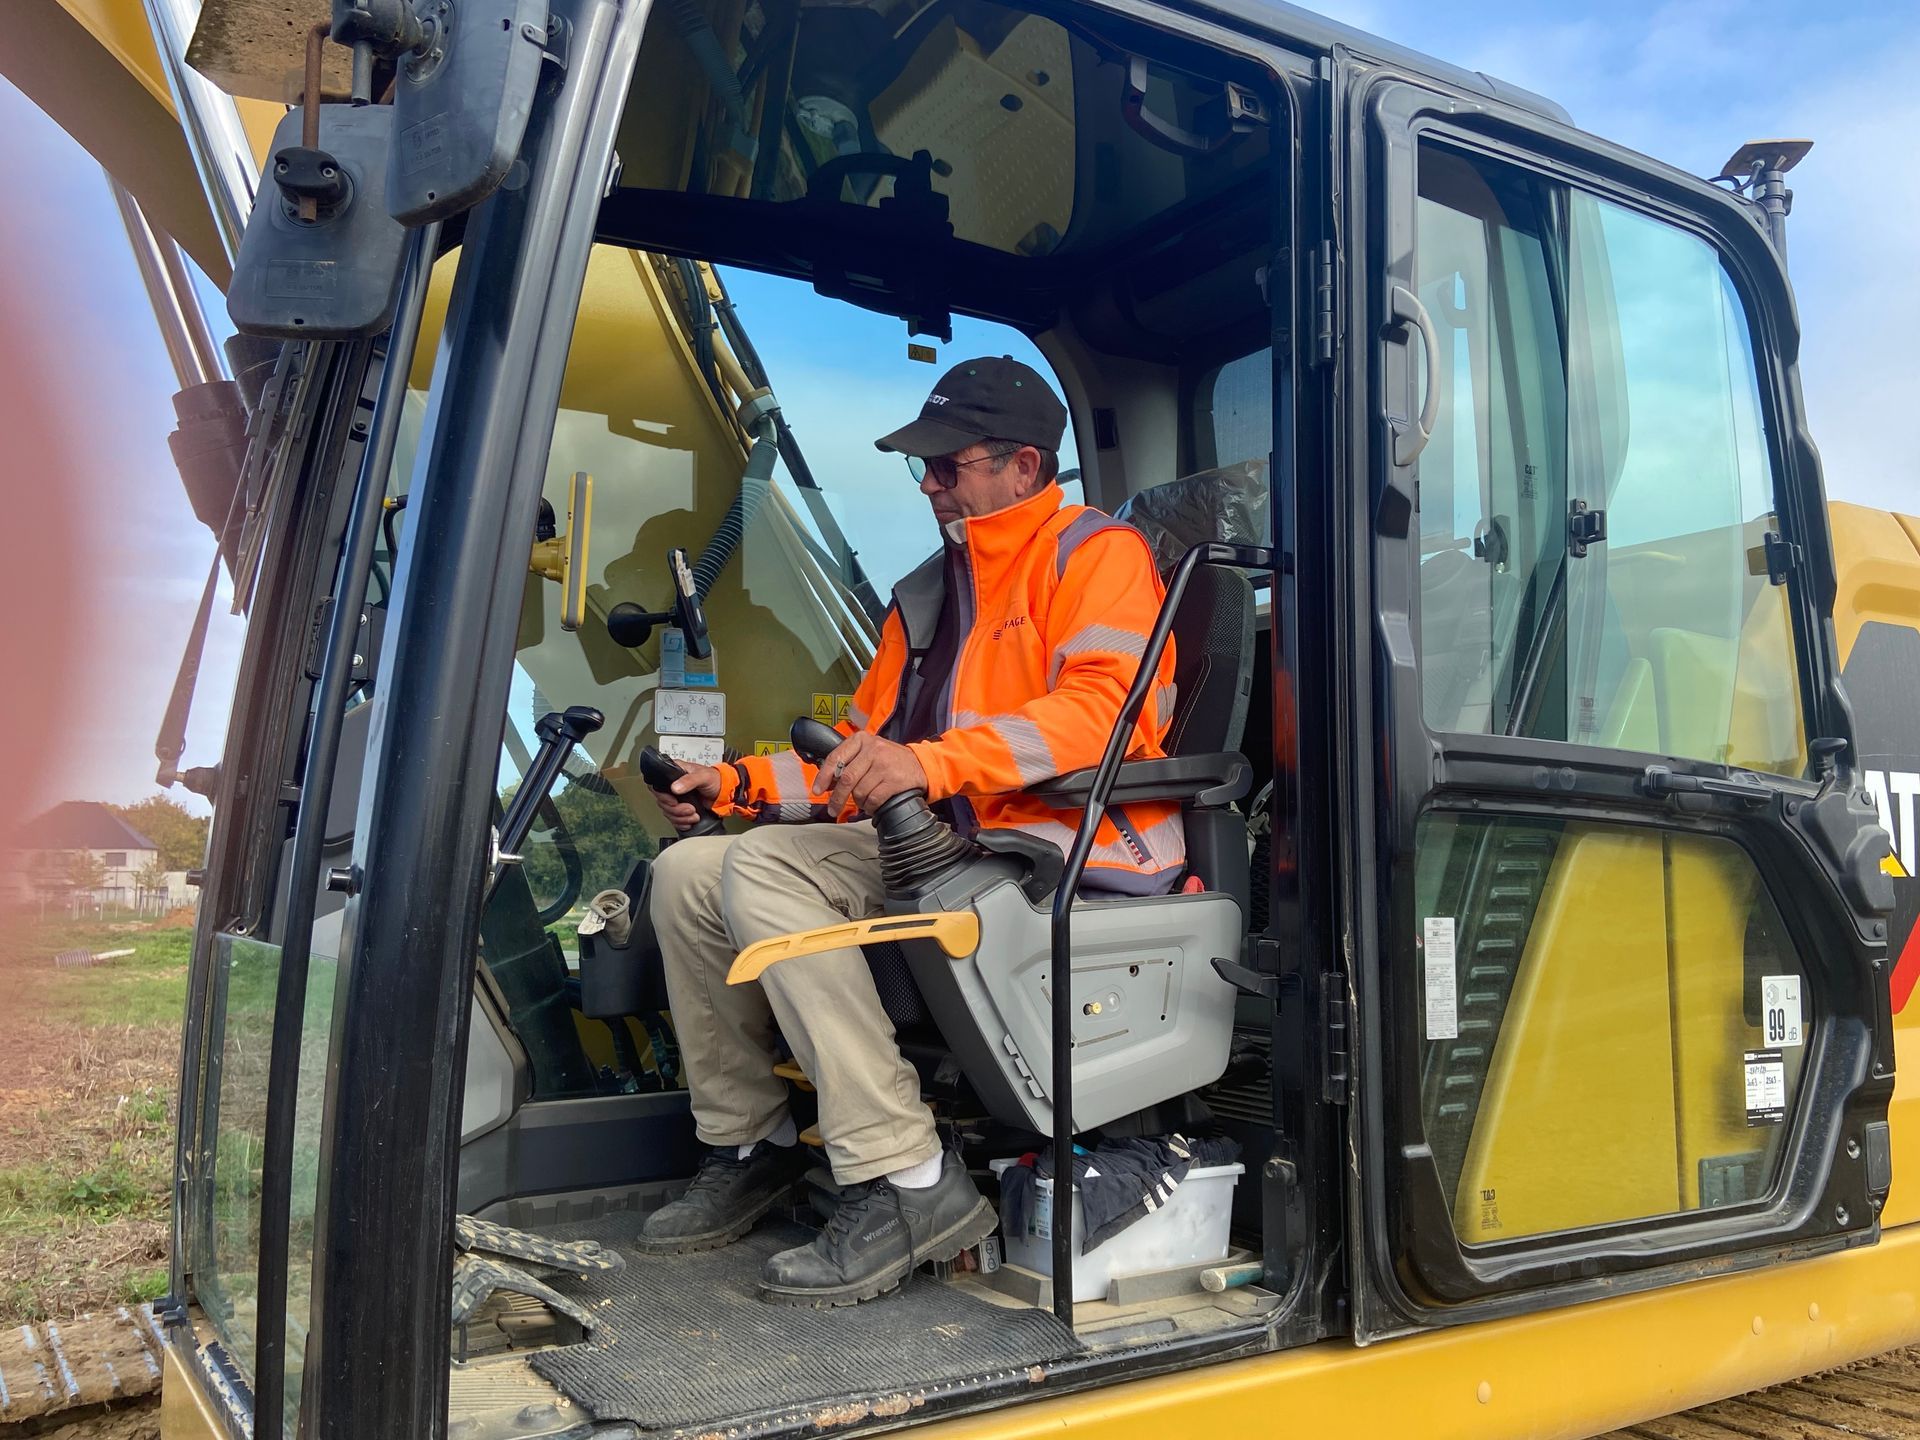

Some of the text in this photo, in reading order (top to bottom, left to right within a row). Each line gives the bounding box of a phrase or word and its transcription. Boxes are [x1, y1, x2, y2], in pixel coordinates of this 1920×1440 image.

[1002, 616, 1026, 629] FAGE
[1864, 769, 1920, 878] AT
[1768, 1008, 1785, 1041] 99
[862, 1217, 900, 1242] Wrangler
